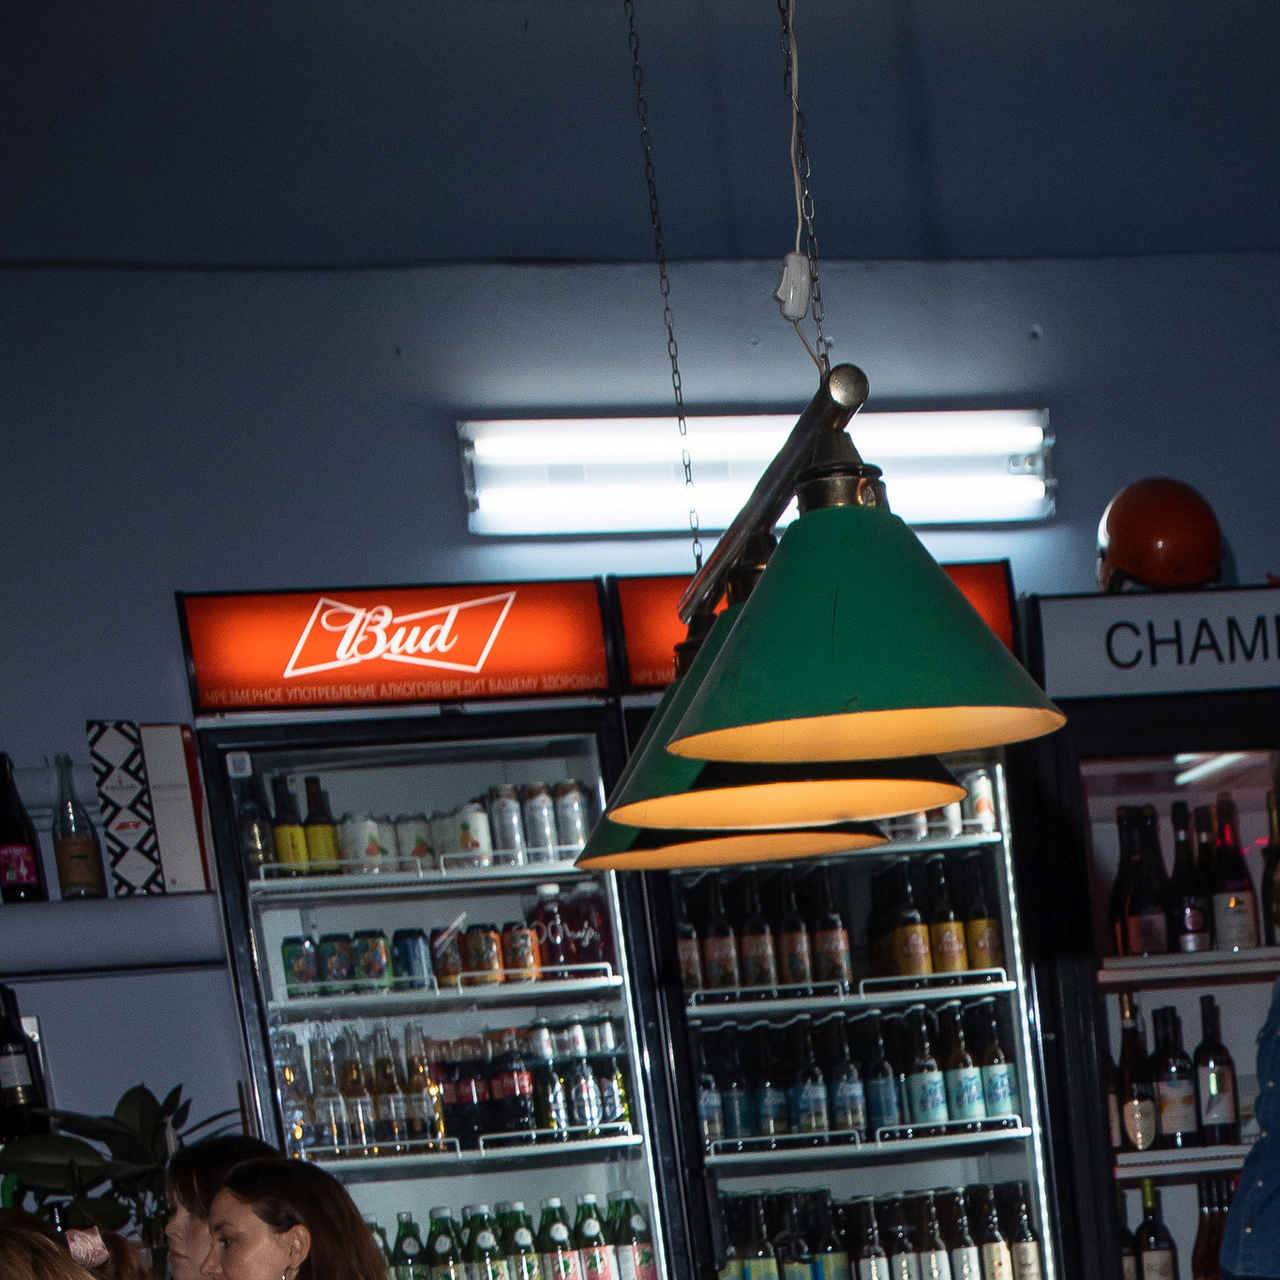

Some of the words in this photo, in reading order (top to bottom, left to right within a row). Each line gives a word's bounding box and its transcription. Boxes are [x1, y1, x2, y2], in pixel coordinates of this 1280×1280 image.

[320, 604, 459, 661] Bud
[205, 687, 282, 703] ЧРЕЗМЕРНОЕ
[286, 683, 376, 701] УПОТРЕБЛЕНИЕ
[379, 679, 441, 698] АЛКОГОЛЯ
[442, 677, 486, 695] ВРЕДИТ
[488, 676, 539, 693] ВАШЕМУ
